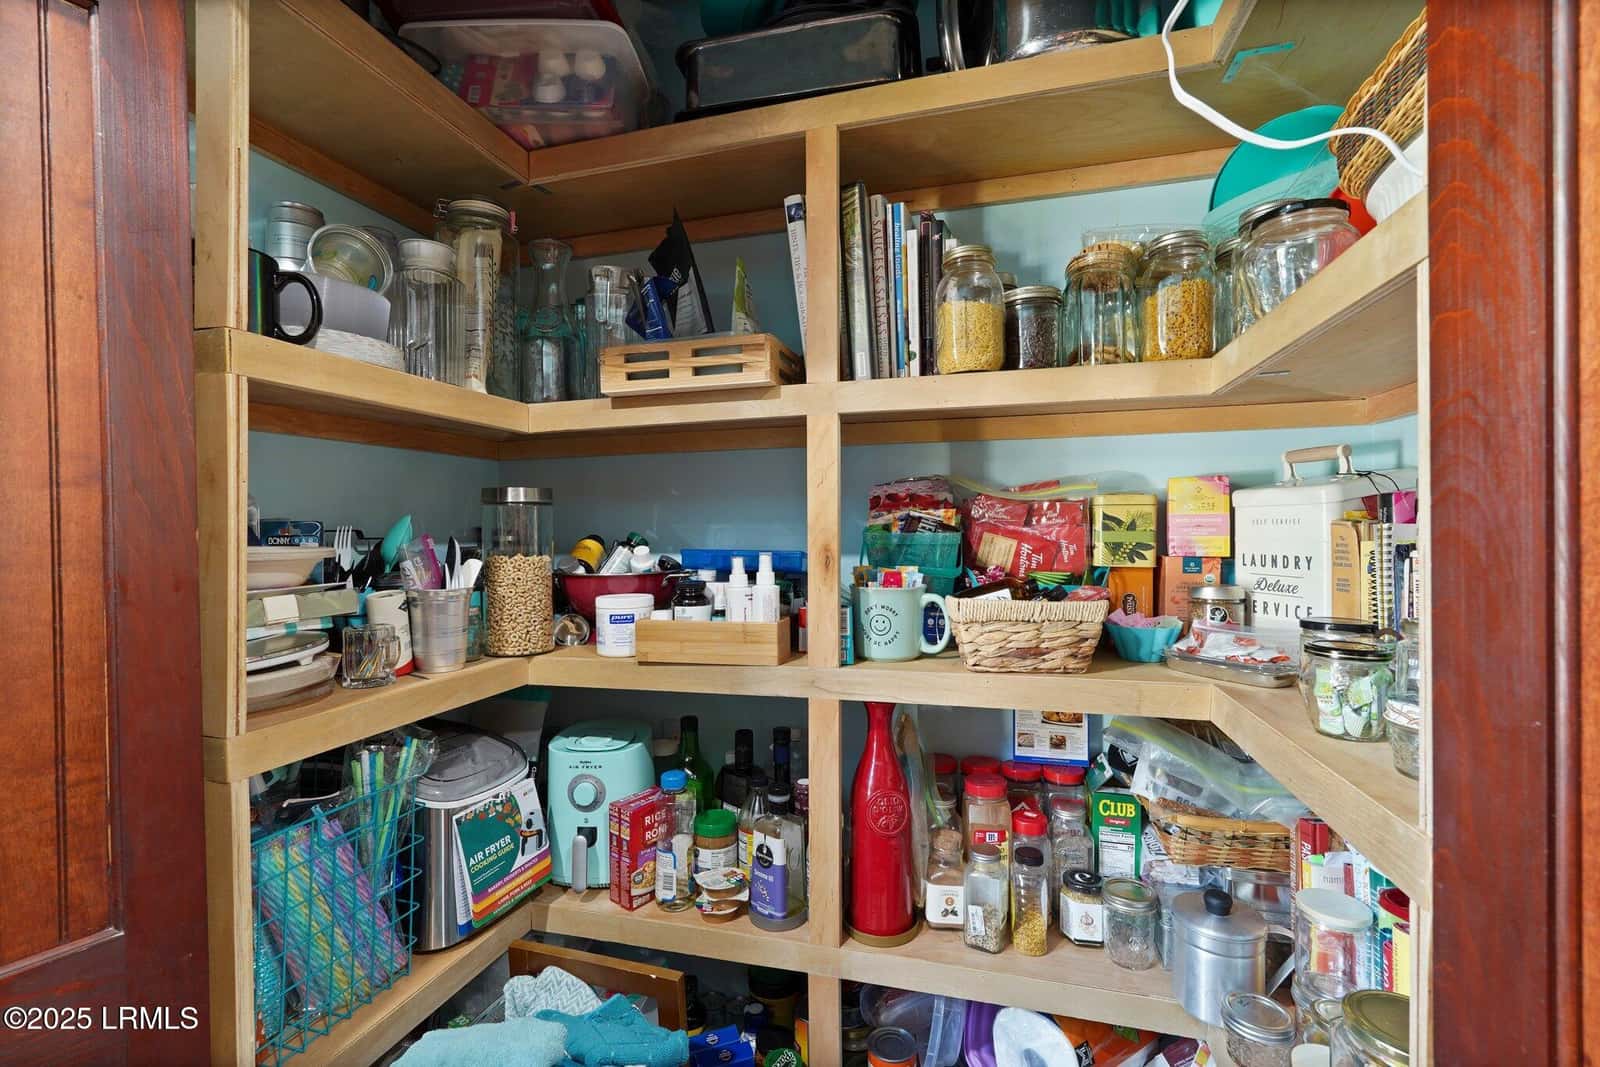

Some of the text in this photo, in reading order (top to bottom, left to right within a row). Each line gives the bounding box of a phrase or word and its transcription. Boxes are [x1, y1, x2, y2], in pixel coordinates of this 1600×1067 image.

[872, 219, 885, 271] SAUCES
[875, 288, 888, 336] SALSAS
[1019, 542, 1033, 577] Hortons
[1031, 552, 1043, 570] Tim
[1242, 553, 1313, 571] LAUNDRY
[1253, 576, 1299, 594] Deluxe
[881, 604, 899, 617] WORRY
[1252, 599, 1313, 620] ERVICE
[644, 808, 667, 827] RICE
[1099, 799, 1136, 818] CLUB
[645, 823, 668, 841] RONI
[469, 834, 512, 867] AIR FRYER
[470, 855, 498, 874] COOKING
[498, 842, 515, 858] GUIDE
